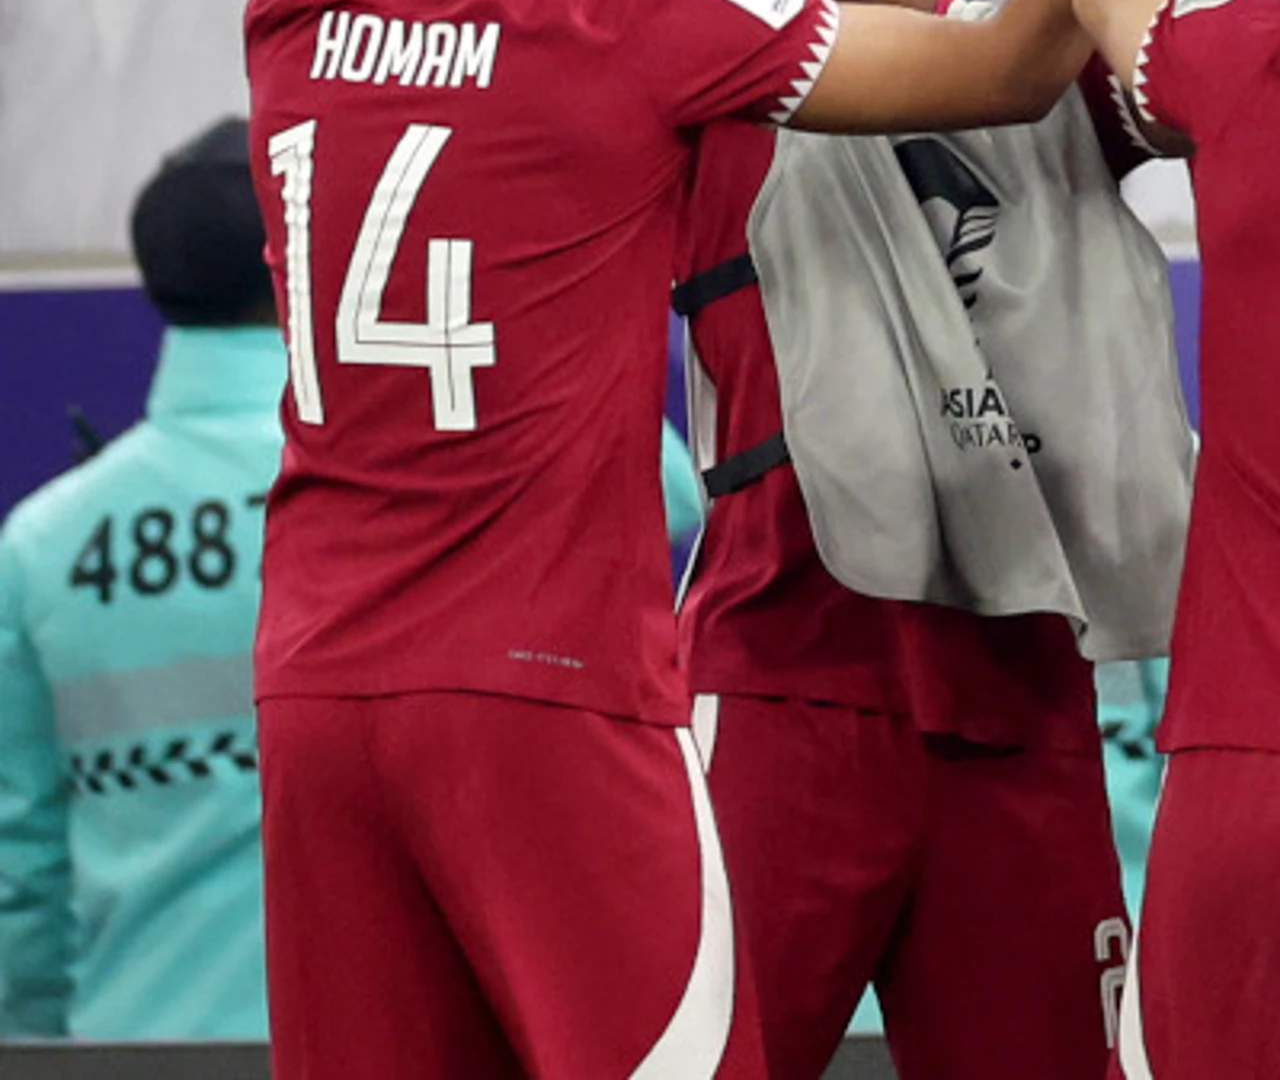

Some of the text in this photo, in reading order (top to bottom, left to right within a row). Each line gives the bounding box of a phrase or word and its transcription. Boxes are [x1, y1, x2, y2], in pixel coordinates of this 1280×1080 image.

[309, 10, 501, 89] HOMAM
[267, 119, 496, 433] 14
[69, 496, 266, 604] 488
